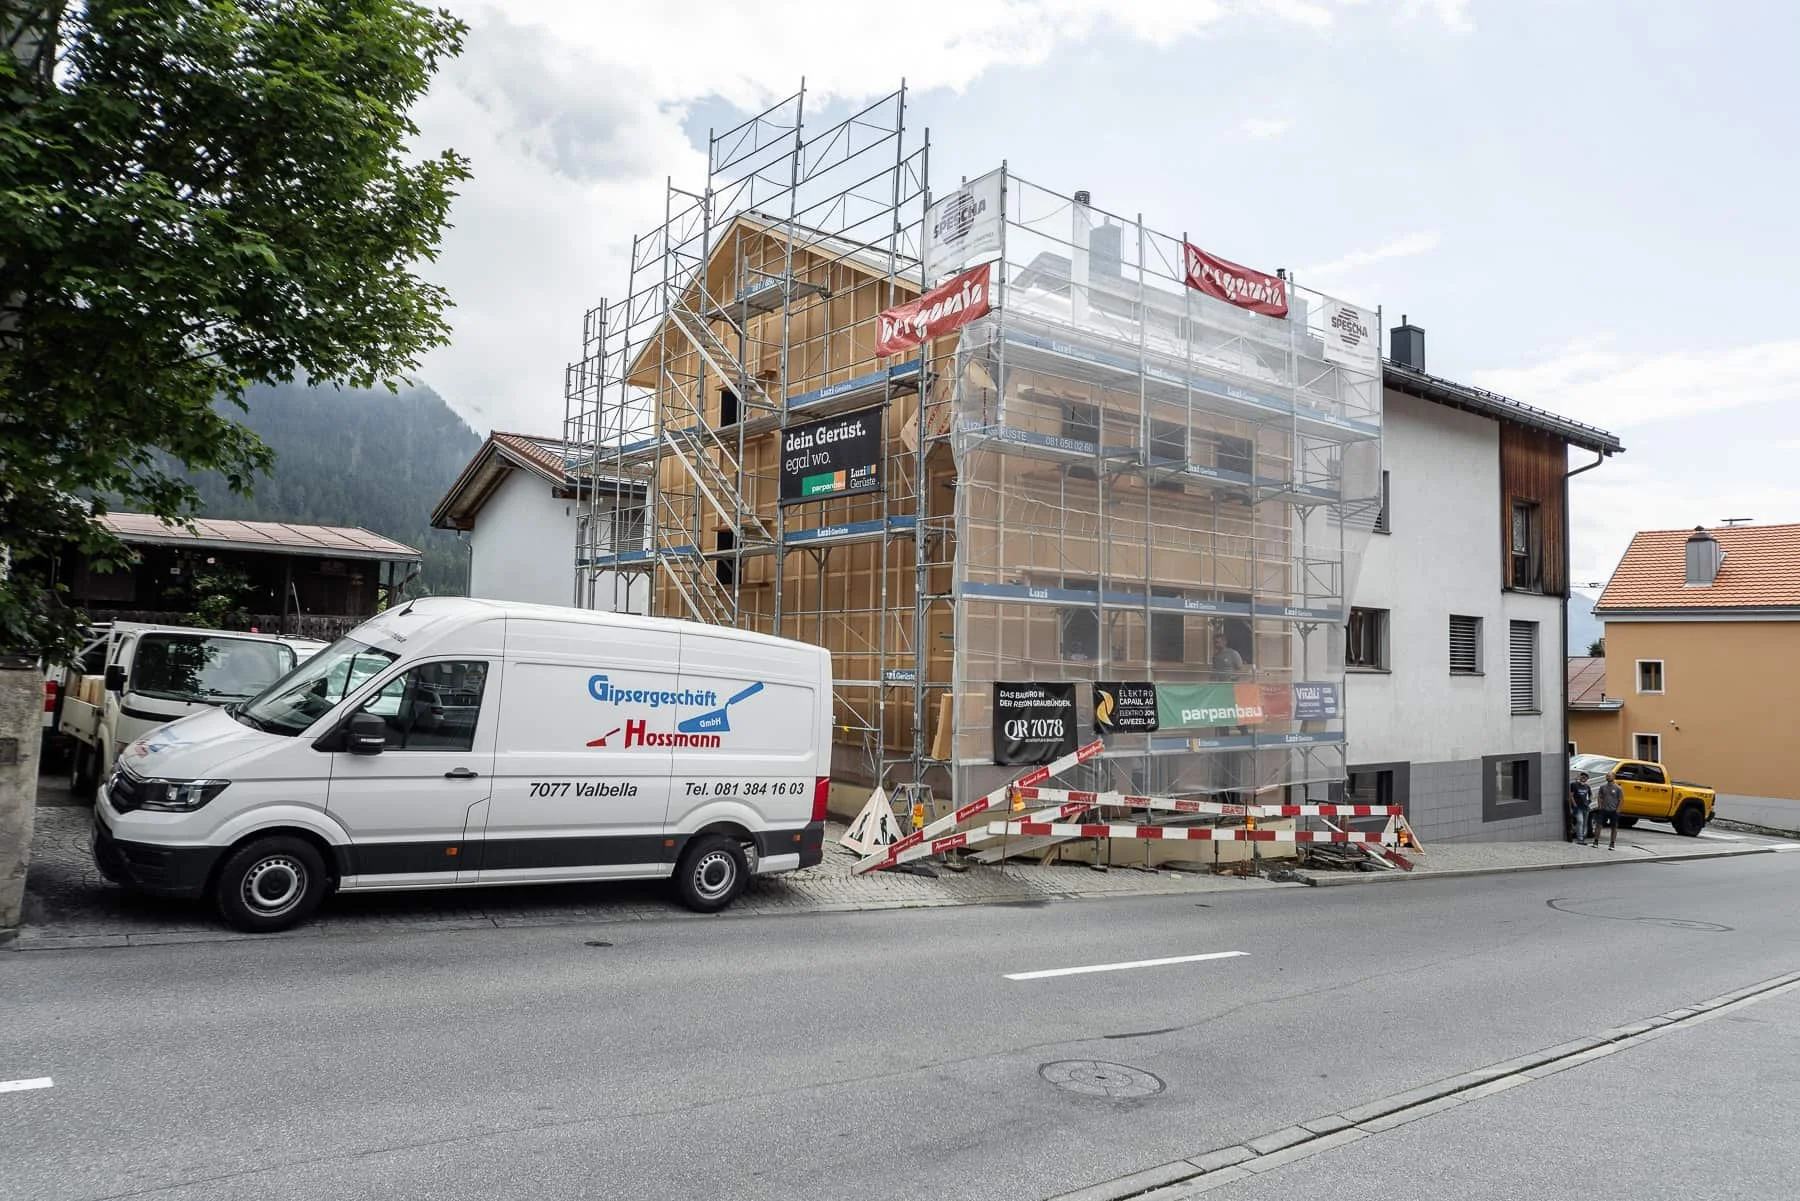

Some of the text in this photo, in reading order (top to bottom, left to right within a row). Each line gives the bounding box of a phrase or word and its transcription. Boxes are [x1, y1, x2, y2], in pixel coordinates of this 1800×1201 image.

[1331, 316, 1368, 338] SPESCHA
[786, 420, 866, 451] dein Gerüst.
[785, 451, 831, 475] egal wo.
[850, 466, 866, 478] Luzi
[588, 674, 717, 707] Gipsergeschäft
[999, 690, 1015, 699] DAS
[1119, 689, 1154, 698] ELEKTRO
[999, 699, 1013, 708] DER
[1119, 698, 1144, 706] CAPAUL
[699, 717, 721, 728] GmbH
[1181, 704, 1263, 724] parpanbau
[625, 719, 720, 749] Hossmann
[1004, 718, 1064, 741] QR 7078
[530, 782, 804, 797] 7077 Valbella Tel. 081 384 16 03
